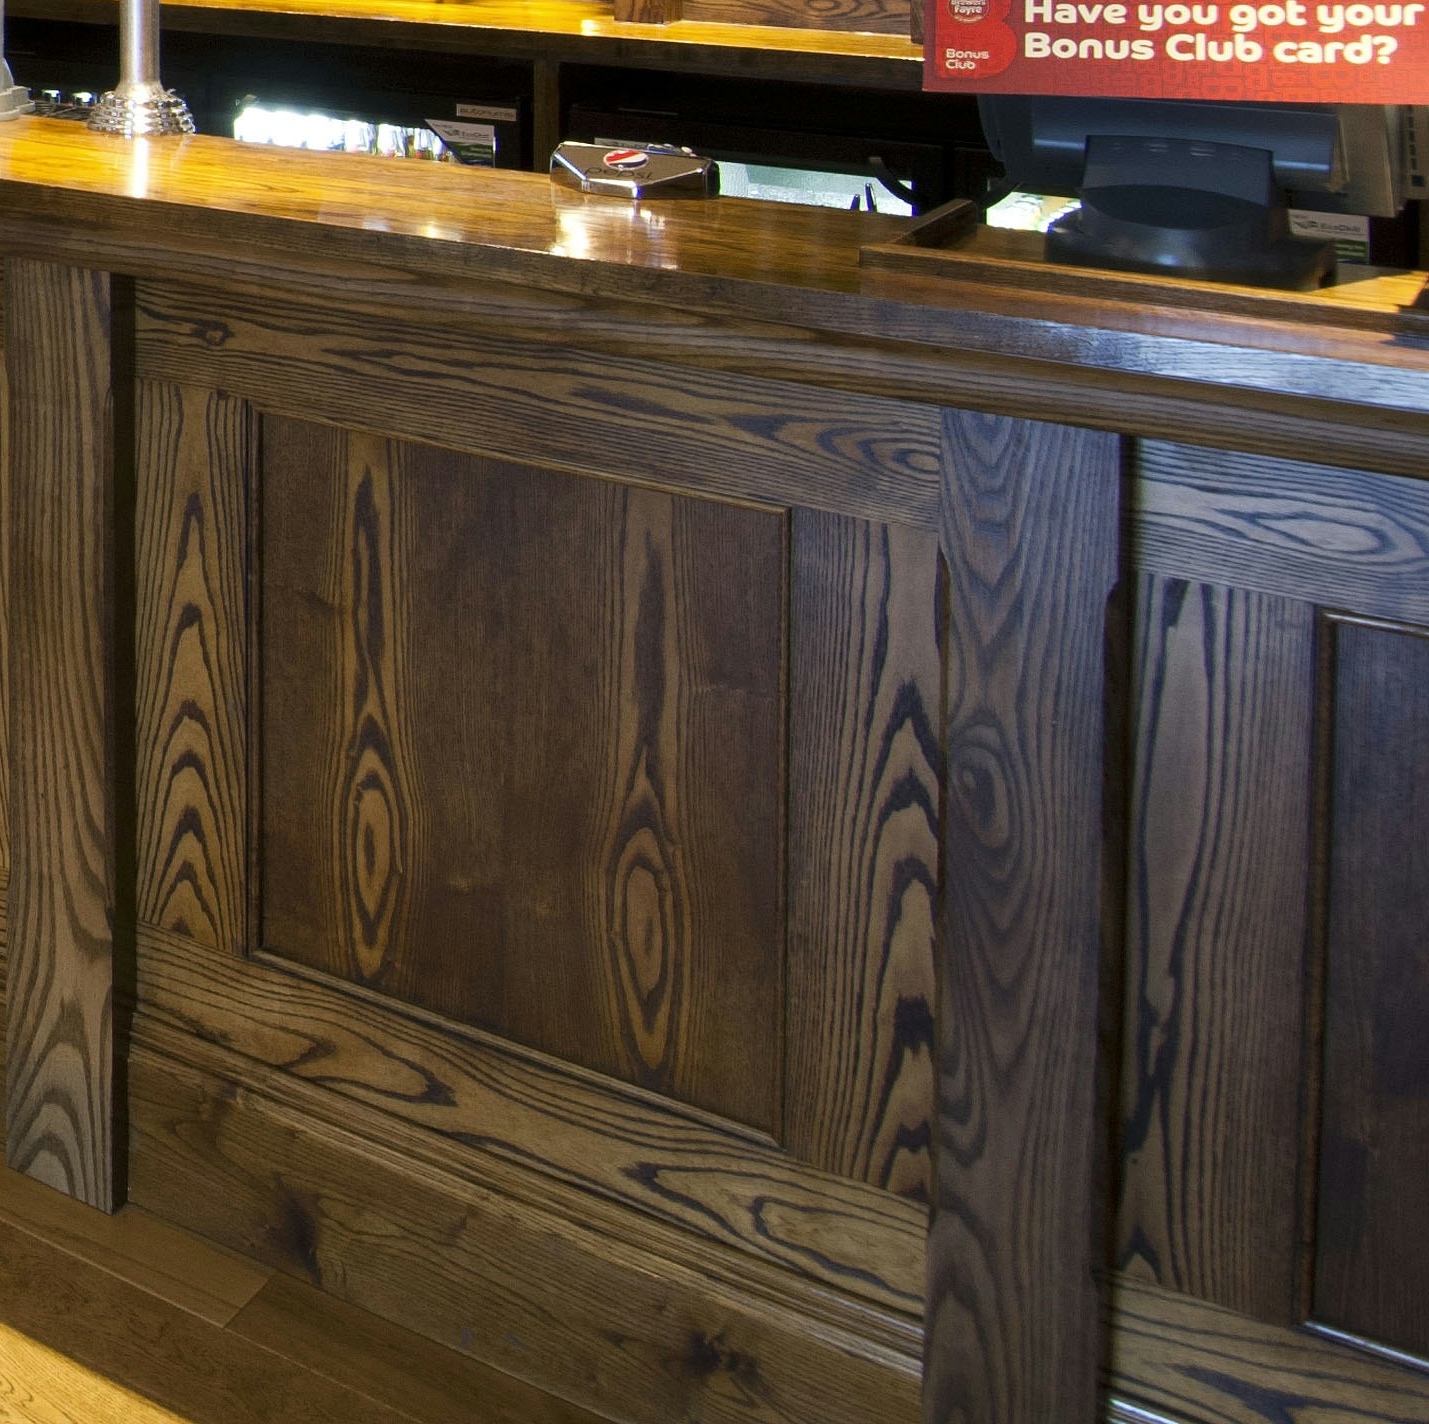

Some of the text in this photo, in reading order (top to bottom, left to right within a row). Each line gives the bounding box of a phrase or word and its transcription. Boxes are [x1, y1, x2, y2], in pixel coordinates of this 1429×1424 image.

[954, 6, 983, 16] Fayre
[1138, 3, 1218, 33] you
[1230, 0, 1308, 34] got
[1318, 3, 1425, 34] your
[946, 47, 990, 60] Bonus
[1025, 33, 1399, 65] Bonus Club card?
[945, 58, 977, 70] Club
